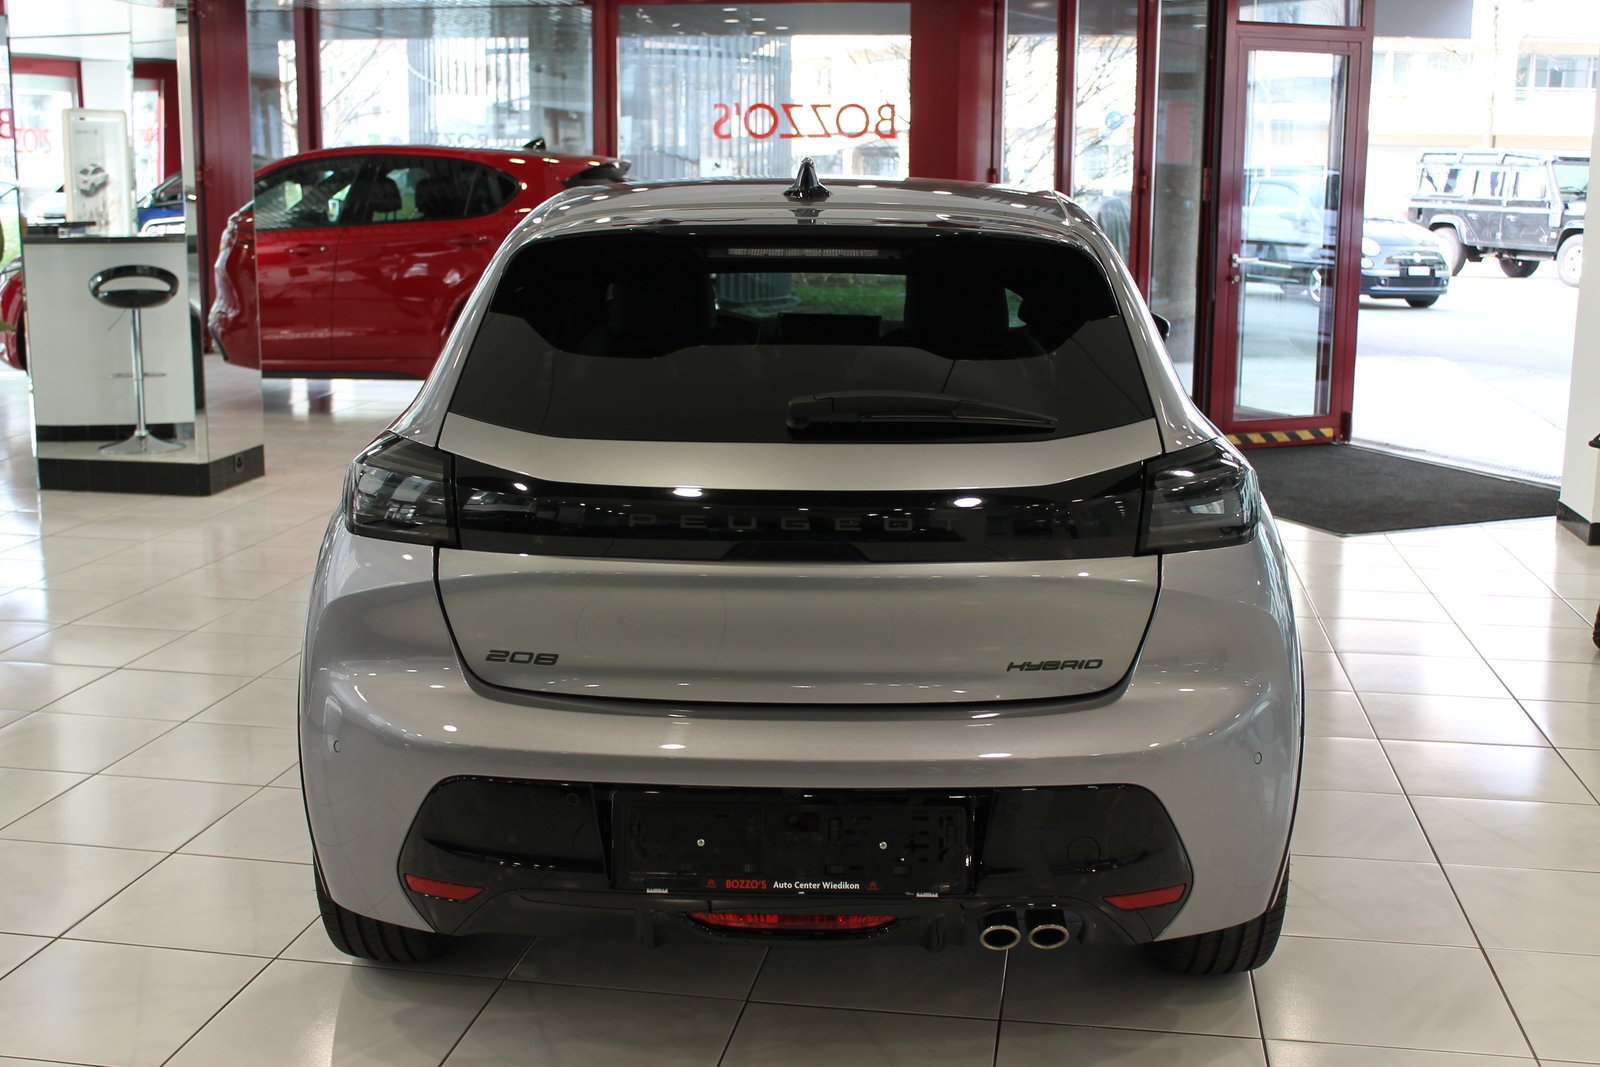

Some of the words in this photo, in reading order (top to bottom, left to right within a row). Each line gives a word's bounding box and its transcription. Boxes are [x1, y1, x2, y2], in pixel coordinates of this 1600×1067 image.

[628, 513, 960, 532] PEUGEOT
[485, 649, 559, 666] 208
[1006, 659, 1103, 672] HYBRID
[725, 879, 767, 889] BOZZO'S
[773, 880, 793, 889] Auto
[794, 880, 820, 889] Center
[821, 880, 860, 890] Wiedikon
